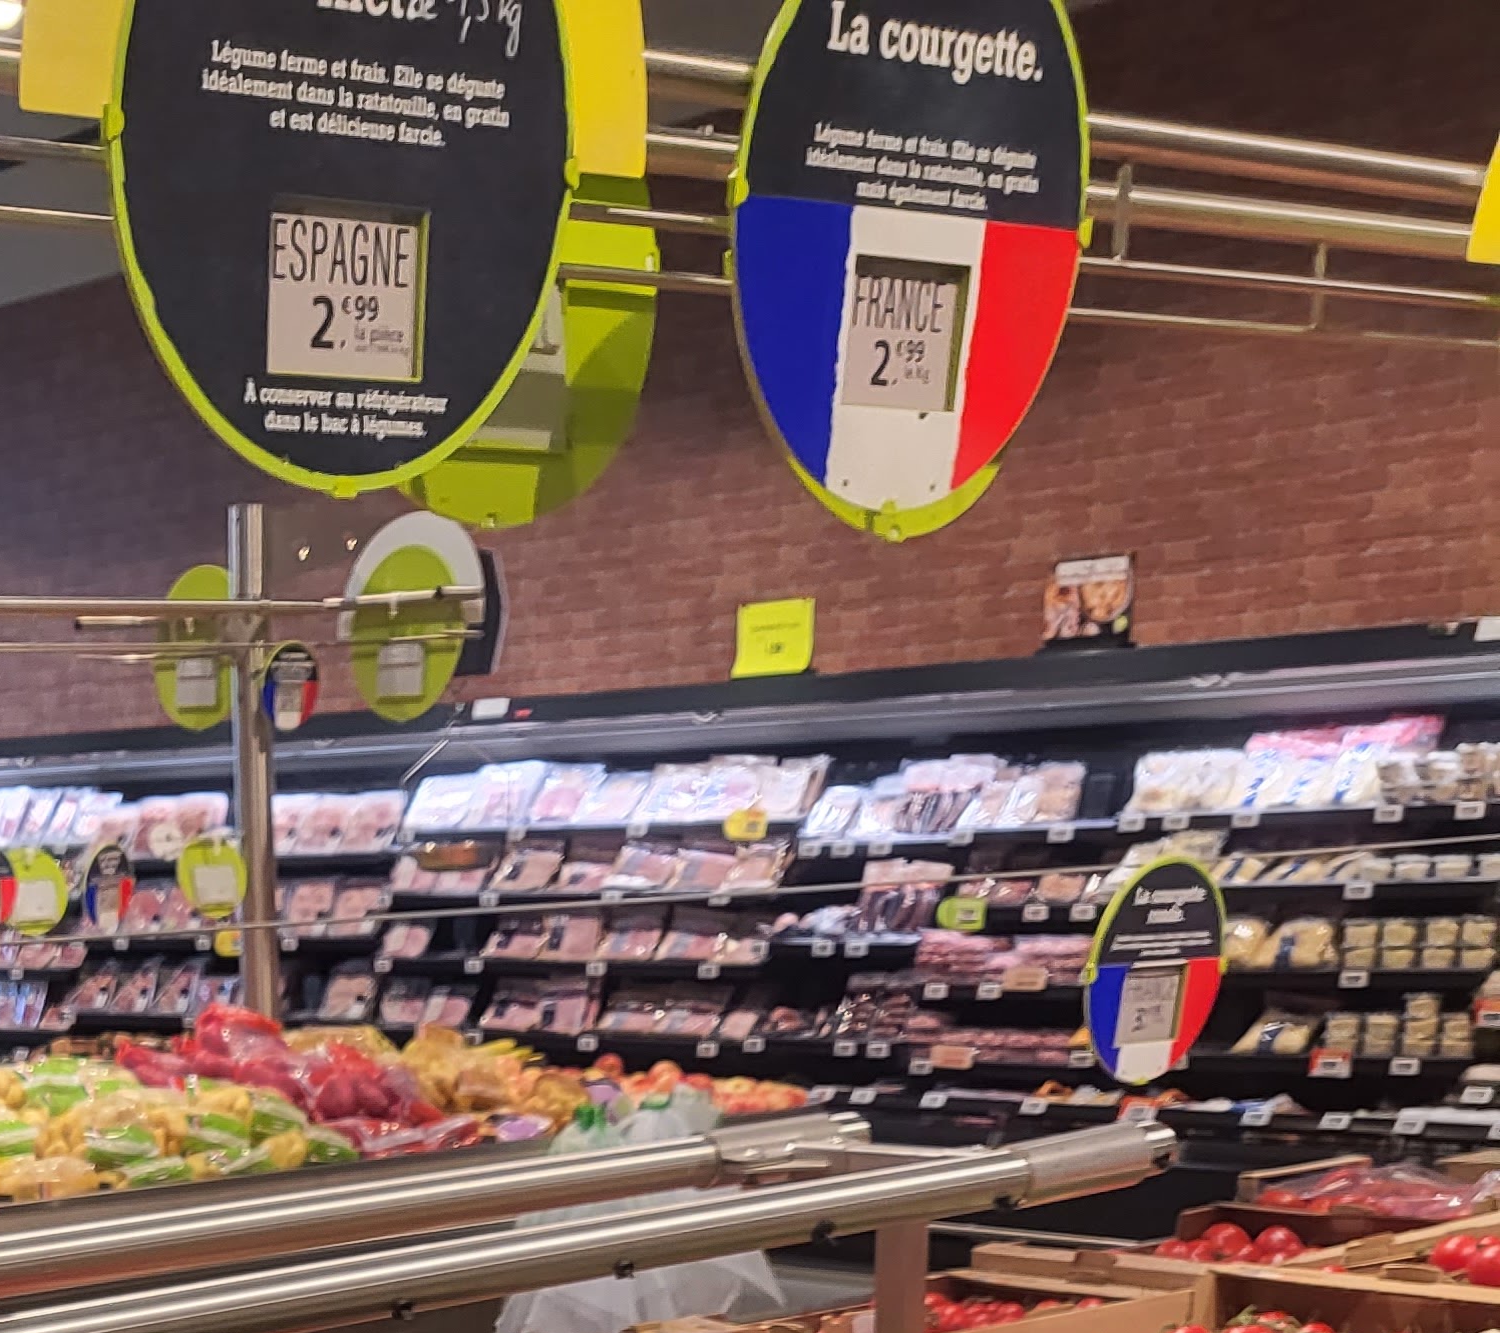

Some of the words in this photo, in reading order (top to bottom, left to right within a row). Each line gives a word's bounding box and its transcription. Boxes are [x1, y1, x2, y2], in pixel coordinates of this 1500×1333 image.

[210, 39, 277, 71] Légume
[279, 49, 328, 77] ferme
[330, 58, 348, 80] et
[393, 64, 424, 89] Elle
[425, 73, 444, 91] se
[446, 72, 506, 101] déguste
[827, 0, 870, 56] La
[879, 18, 1044, 85] courgette.
[202, 67, 293, 101] idéalement
[296, 81, 335, 105] dans
[338, 85, 354, 108] la
[442, 103, 463, 121] en
[464, 105, 510, 129] gratin
[269, 108, 286, 129] et
[289, 111, 315, 131] est
[316, 111, 396, 143] délicieuse
[273, 218, 410, 288] ESPAGNE
[852, 277, 943, 332] FRANCE
